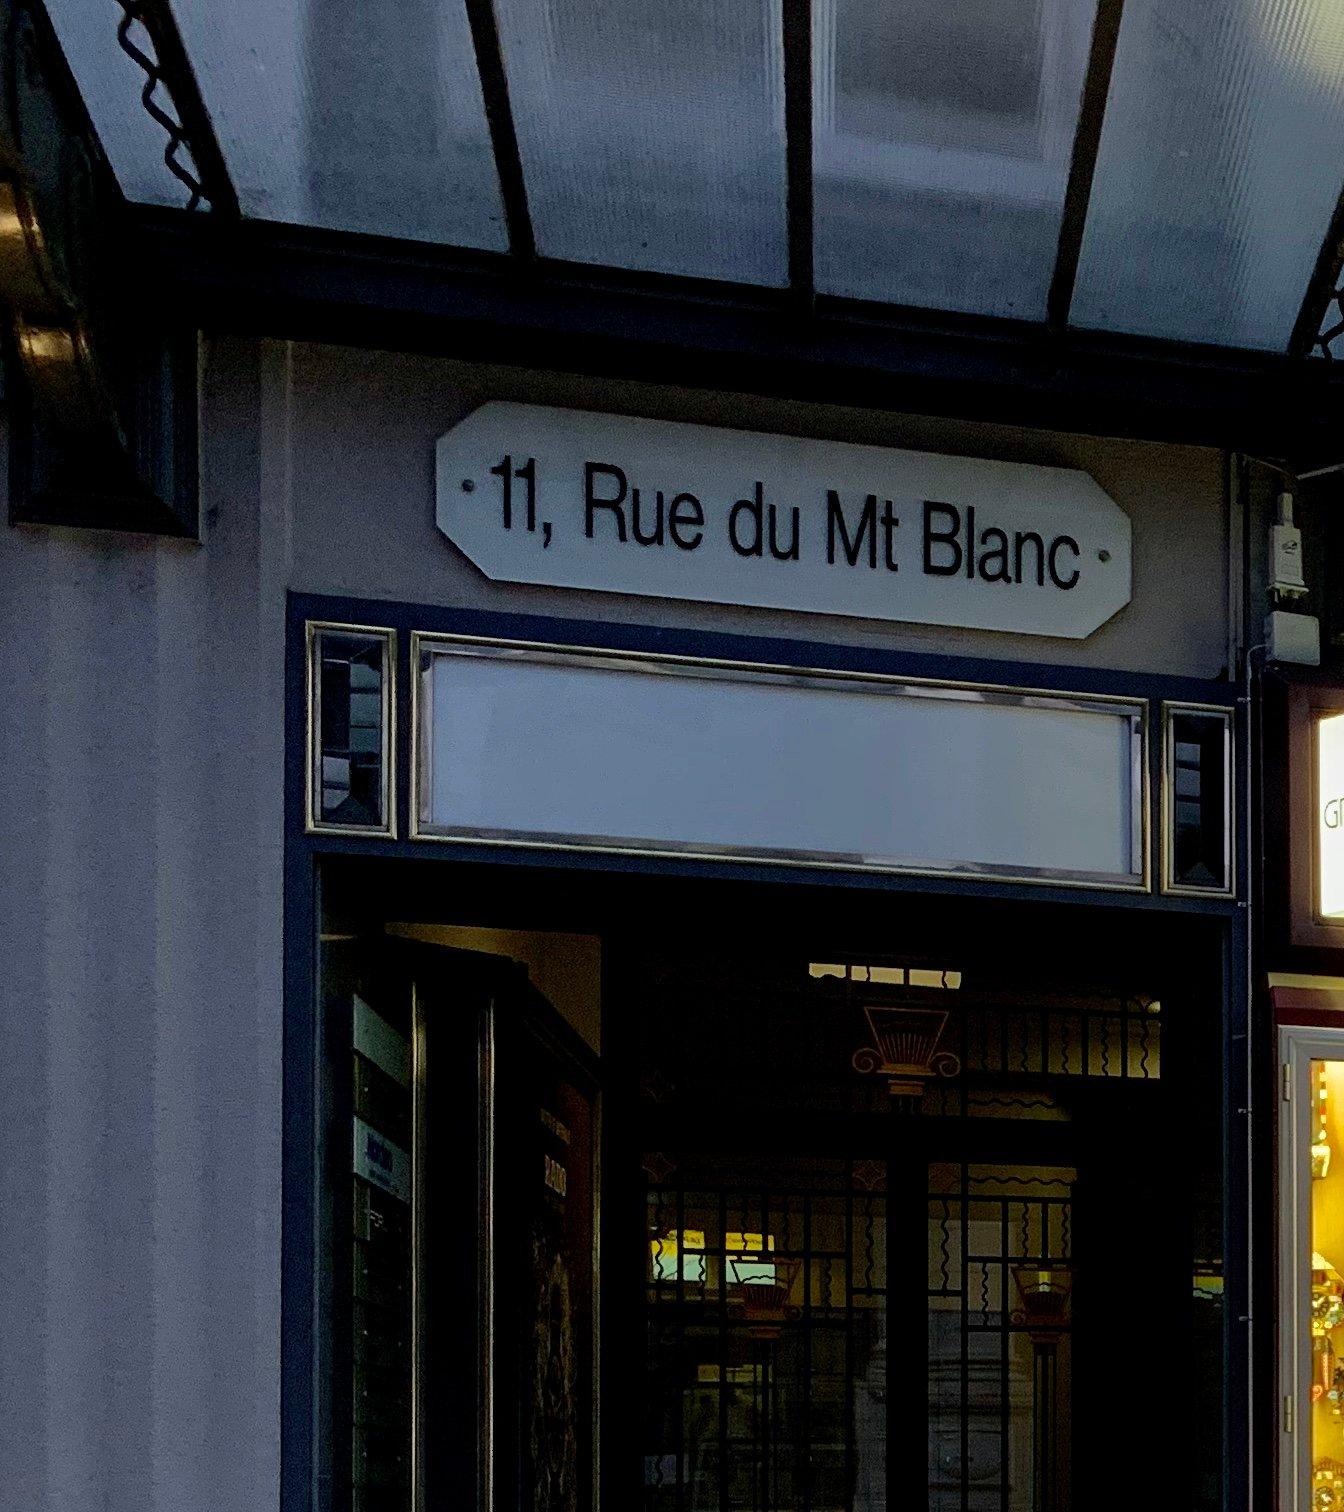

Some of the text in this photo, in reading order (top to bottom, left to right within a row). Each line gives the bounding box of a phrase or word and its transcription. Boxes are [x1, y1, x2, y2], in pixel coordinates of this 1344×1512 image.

[491, 455, 1081, 590] 11, Rue du Mt Blanc
